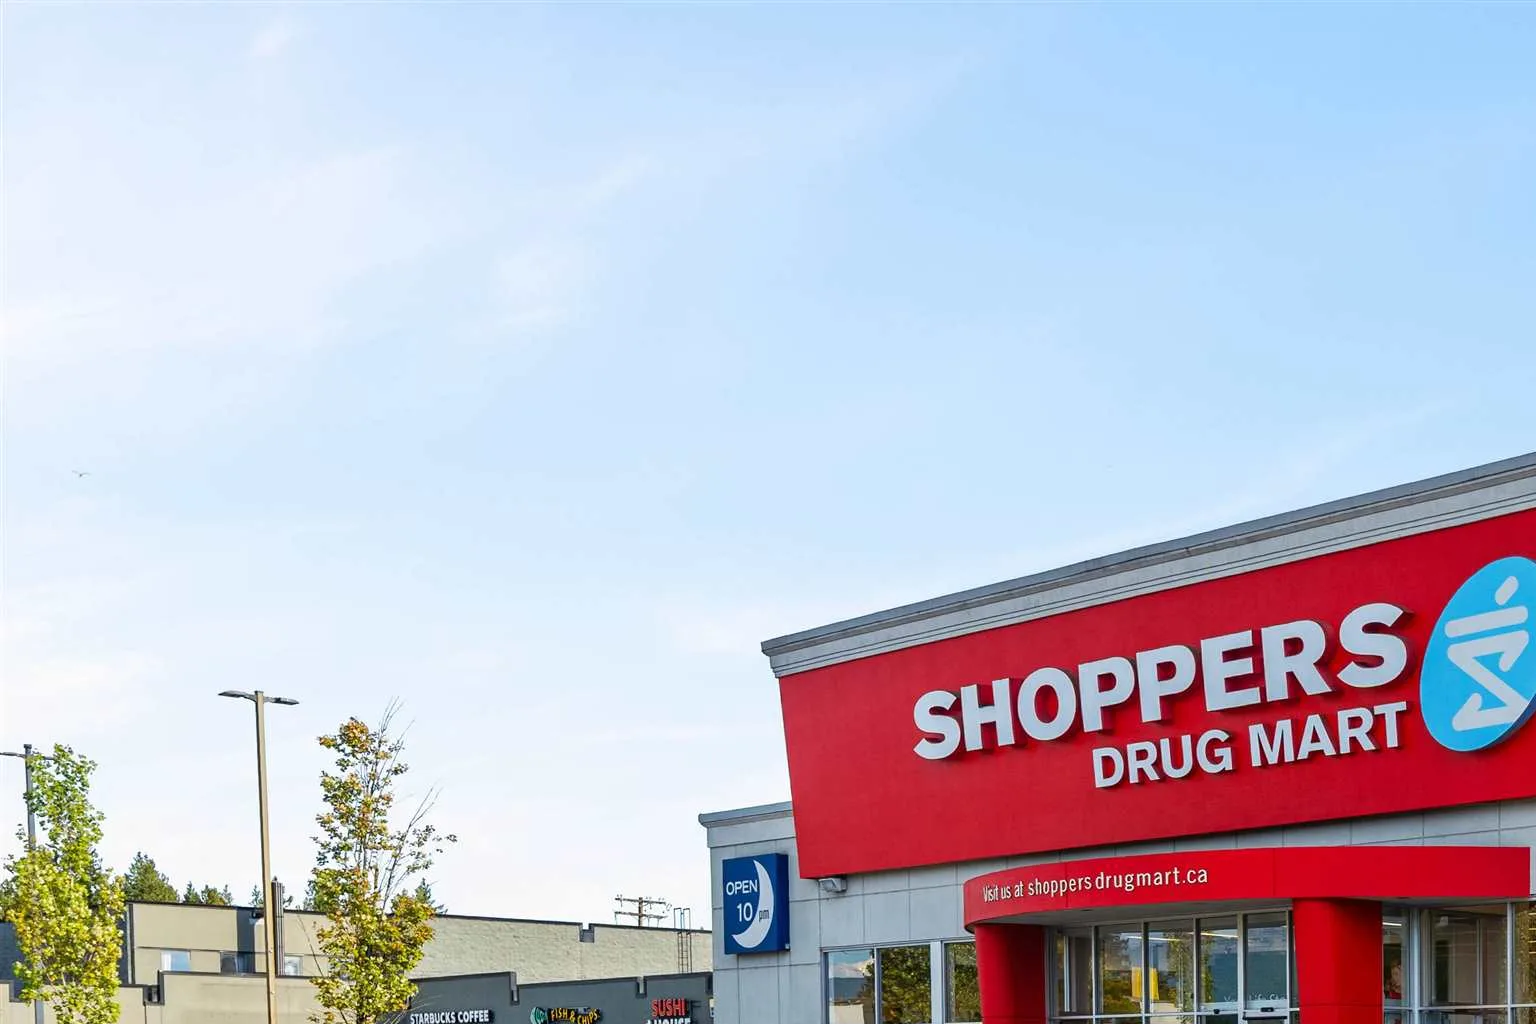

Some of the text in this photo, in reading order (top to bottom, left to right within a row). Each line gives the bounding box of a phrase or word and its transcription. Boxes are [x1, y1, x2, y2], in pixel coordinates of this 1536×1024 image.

[913, 602, 1408, 760] SHOPPERS
[1093, 701, 1407, 788] DRUG MART
[726, 879, 758, 896] OPEN
[1001, 886, 1012, 899] us
[1014, 880, 1024, 897] at
[736, 902, 754, 922] 10
[410, 1009, 489, 1024] STARBUCKS COFFEE
[550, 1007, 567, 1021] FISH
[651, 998, 685, 1017] SUSHI
